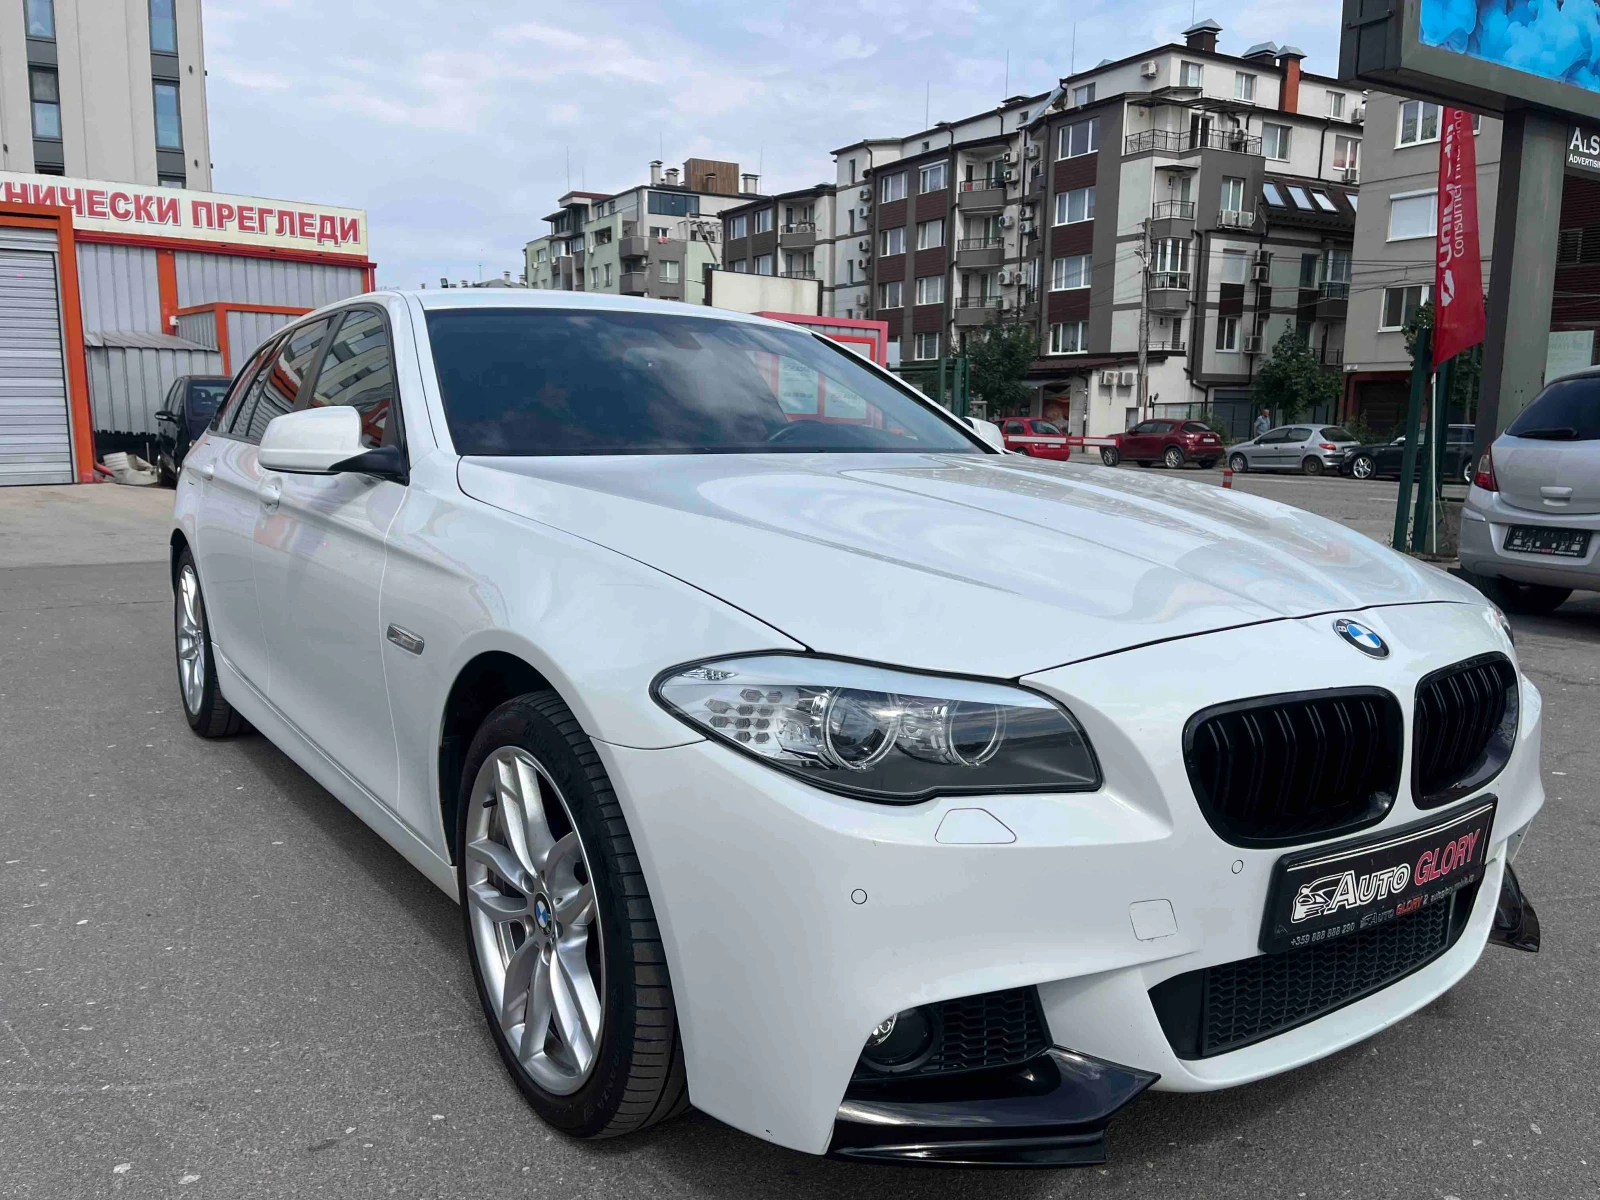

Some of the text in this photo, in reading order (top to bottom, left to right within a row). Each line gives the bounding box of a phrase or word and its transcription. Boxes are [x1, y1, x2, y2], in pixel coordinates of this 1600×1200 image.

[0, 181, 361, 246] НИЧЕСКИ ПРЕГЛЕДИ
[1414, 829, 1480, 886] GLORY
[1291, 933, 1310, 946] +359
[1311, 930, 1326, 942] 888
[1327, 926, 1341, 938] 888
[1341, 922, 1356, 934] 290
[1396, 895, 1423, 916] GLORY
